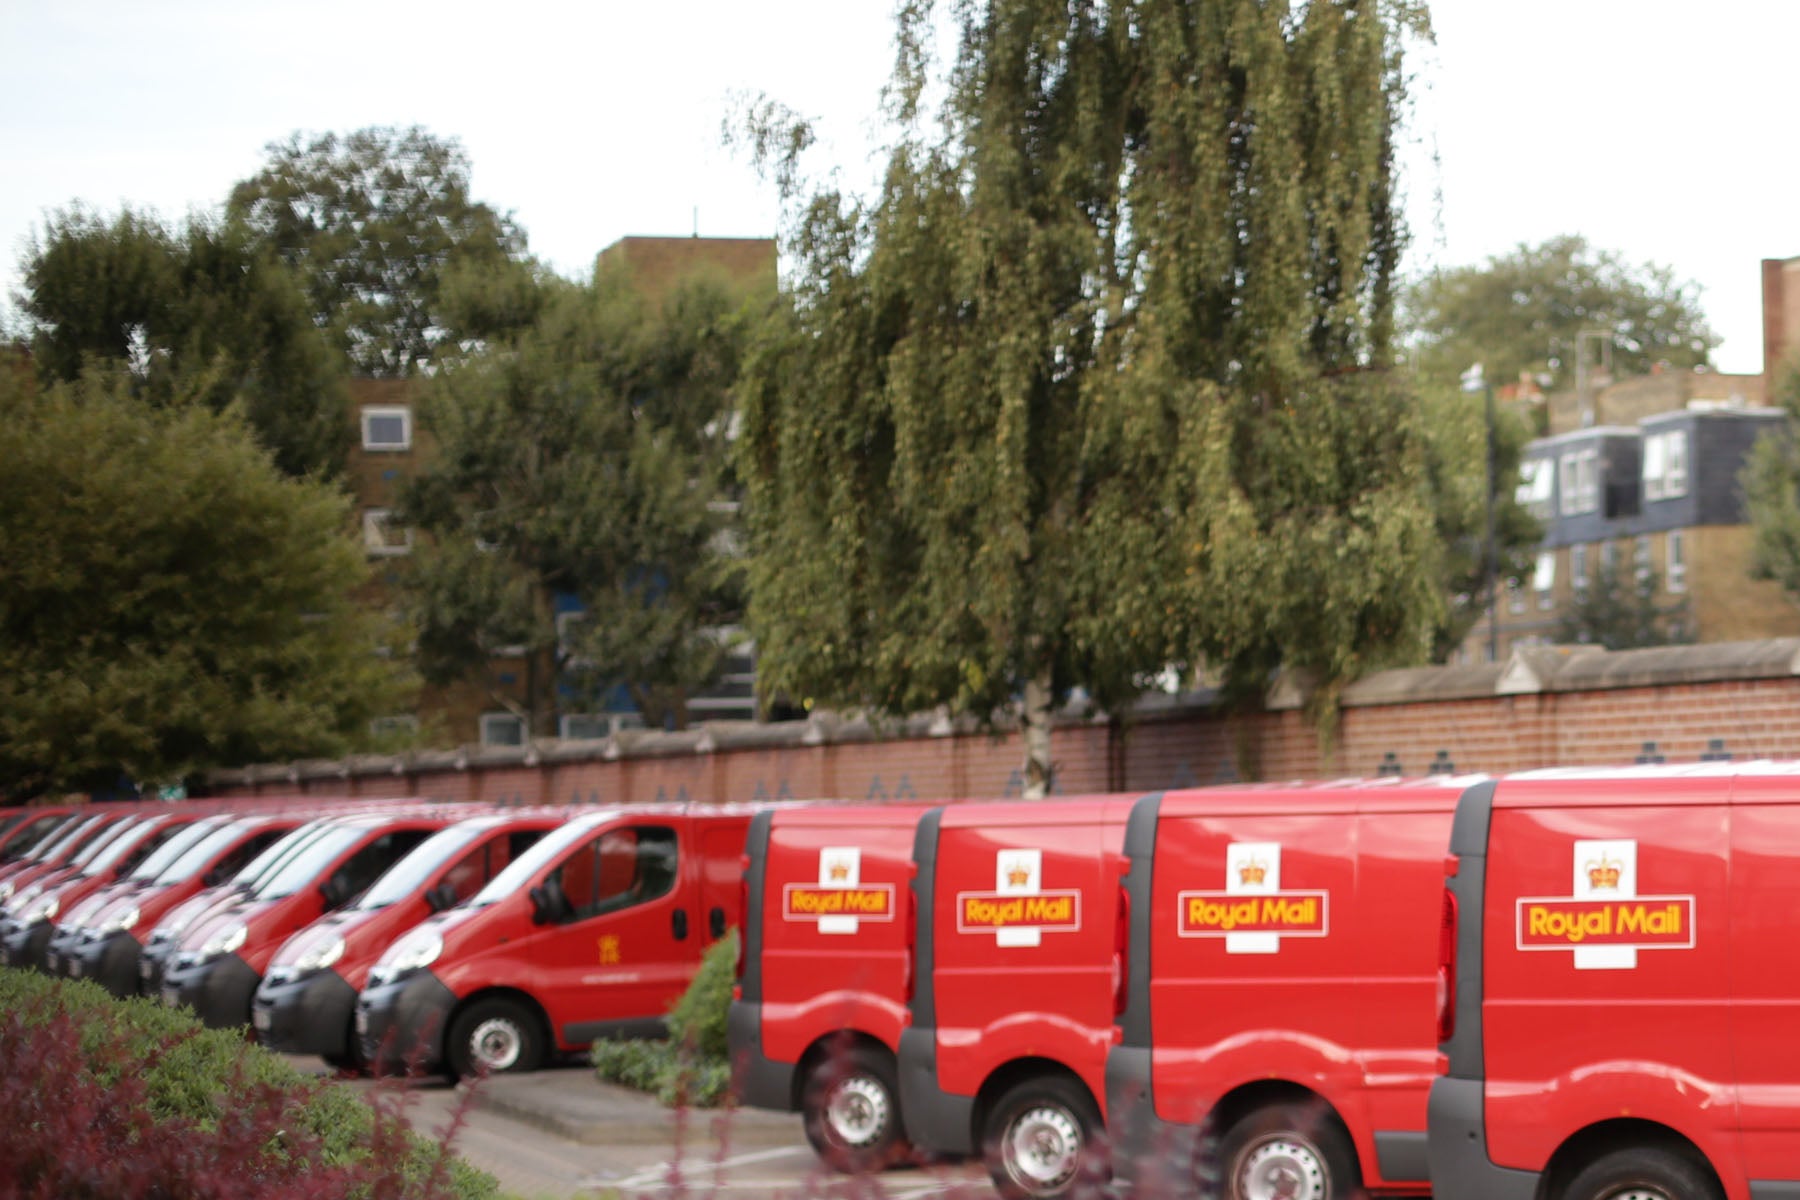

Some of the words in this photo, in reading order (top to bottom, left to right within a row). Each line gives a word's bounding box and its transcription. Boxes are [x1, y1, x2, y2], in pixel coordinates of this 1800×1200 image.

[791, 889, 843, 914] Royal
[844, 890, 887, 912] Mail
[966, 898, 1023, 926] Royal
[1026, 897, 1071, 921] Mail
[1190, 900, 1258, 930] Royal
[1261, 899, 1316, 924] Mail
[1529, 906, 1612, 941] Royal
[1616, 905, 1682, 935] Mail
